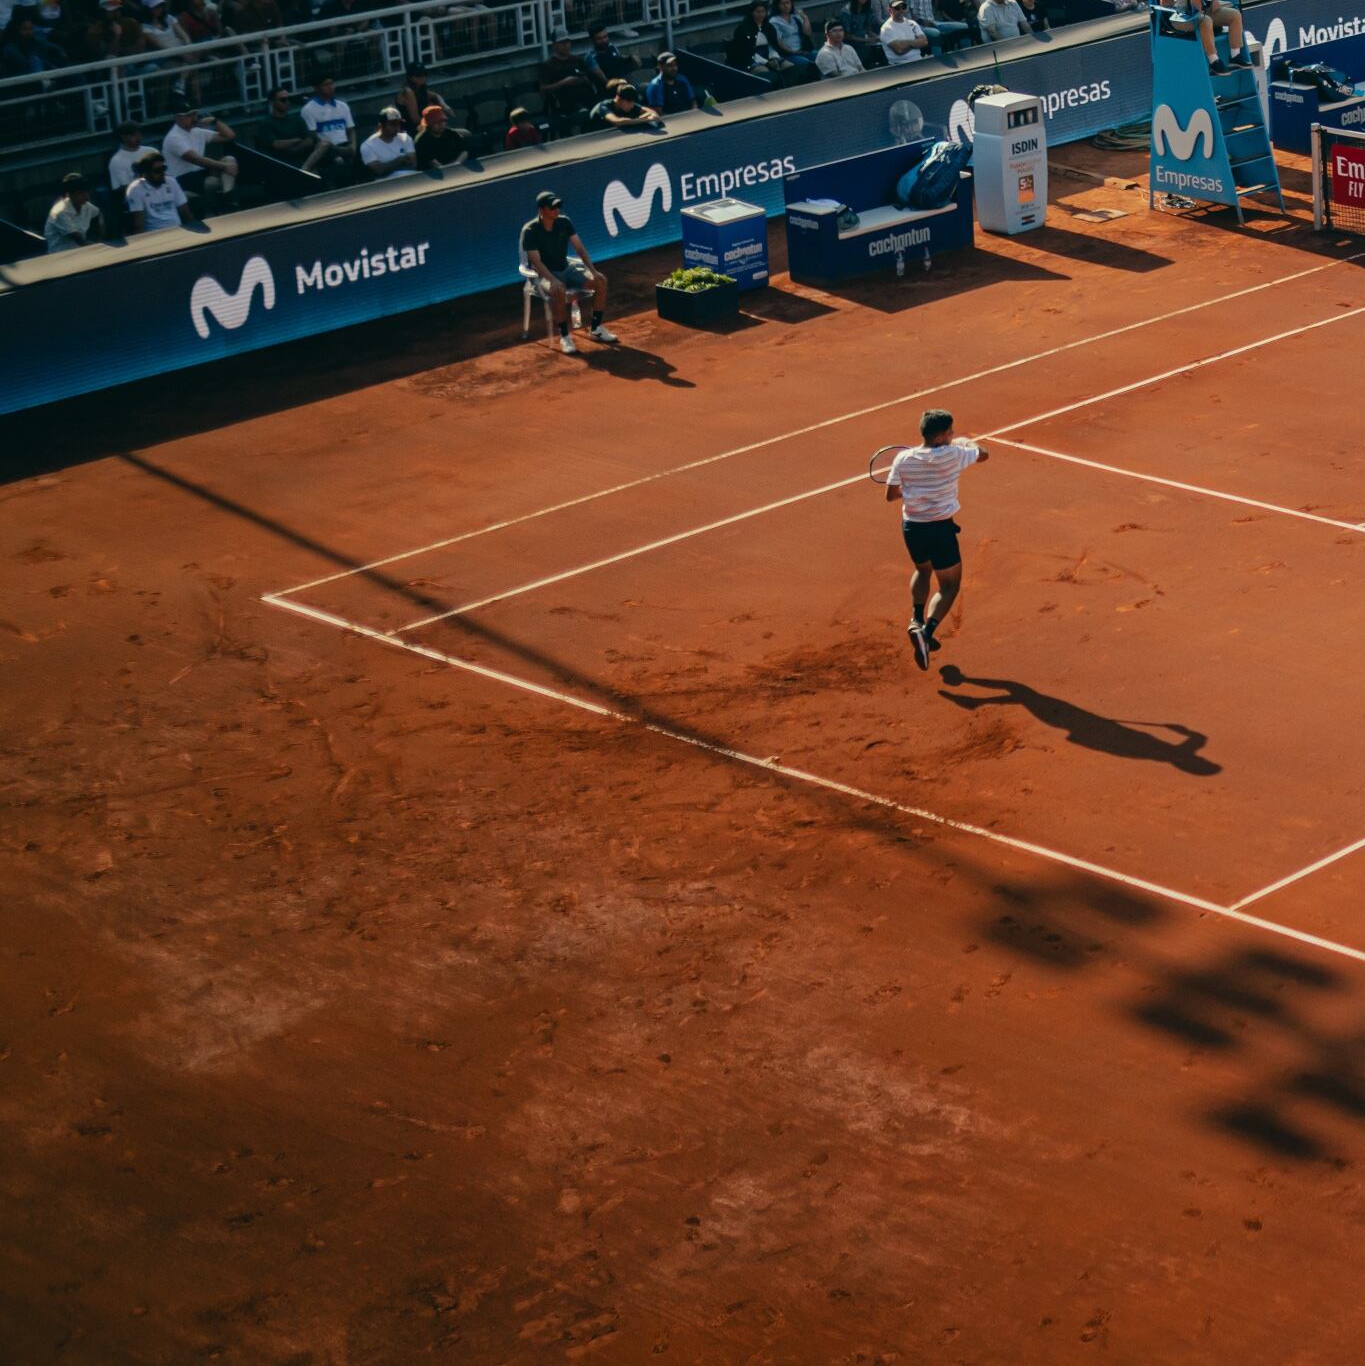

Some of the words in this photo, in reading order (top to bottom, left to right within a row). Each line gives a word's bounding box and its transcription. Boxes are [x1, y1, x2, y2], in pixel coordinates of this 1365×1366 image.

[1011, 137, 1038, 155] ISDIN
[681, 155, 796, 199] Empresas
[1155, 165, 1223, 194] Empresas
[1348, 181, 1365, 199] FLY
[295, 242, 430, 295] Movistar
